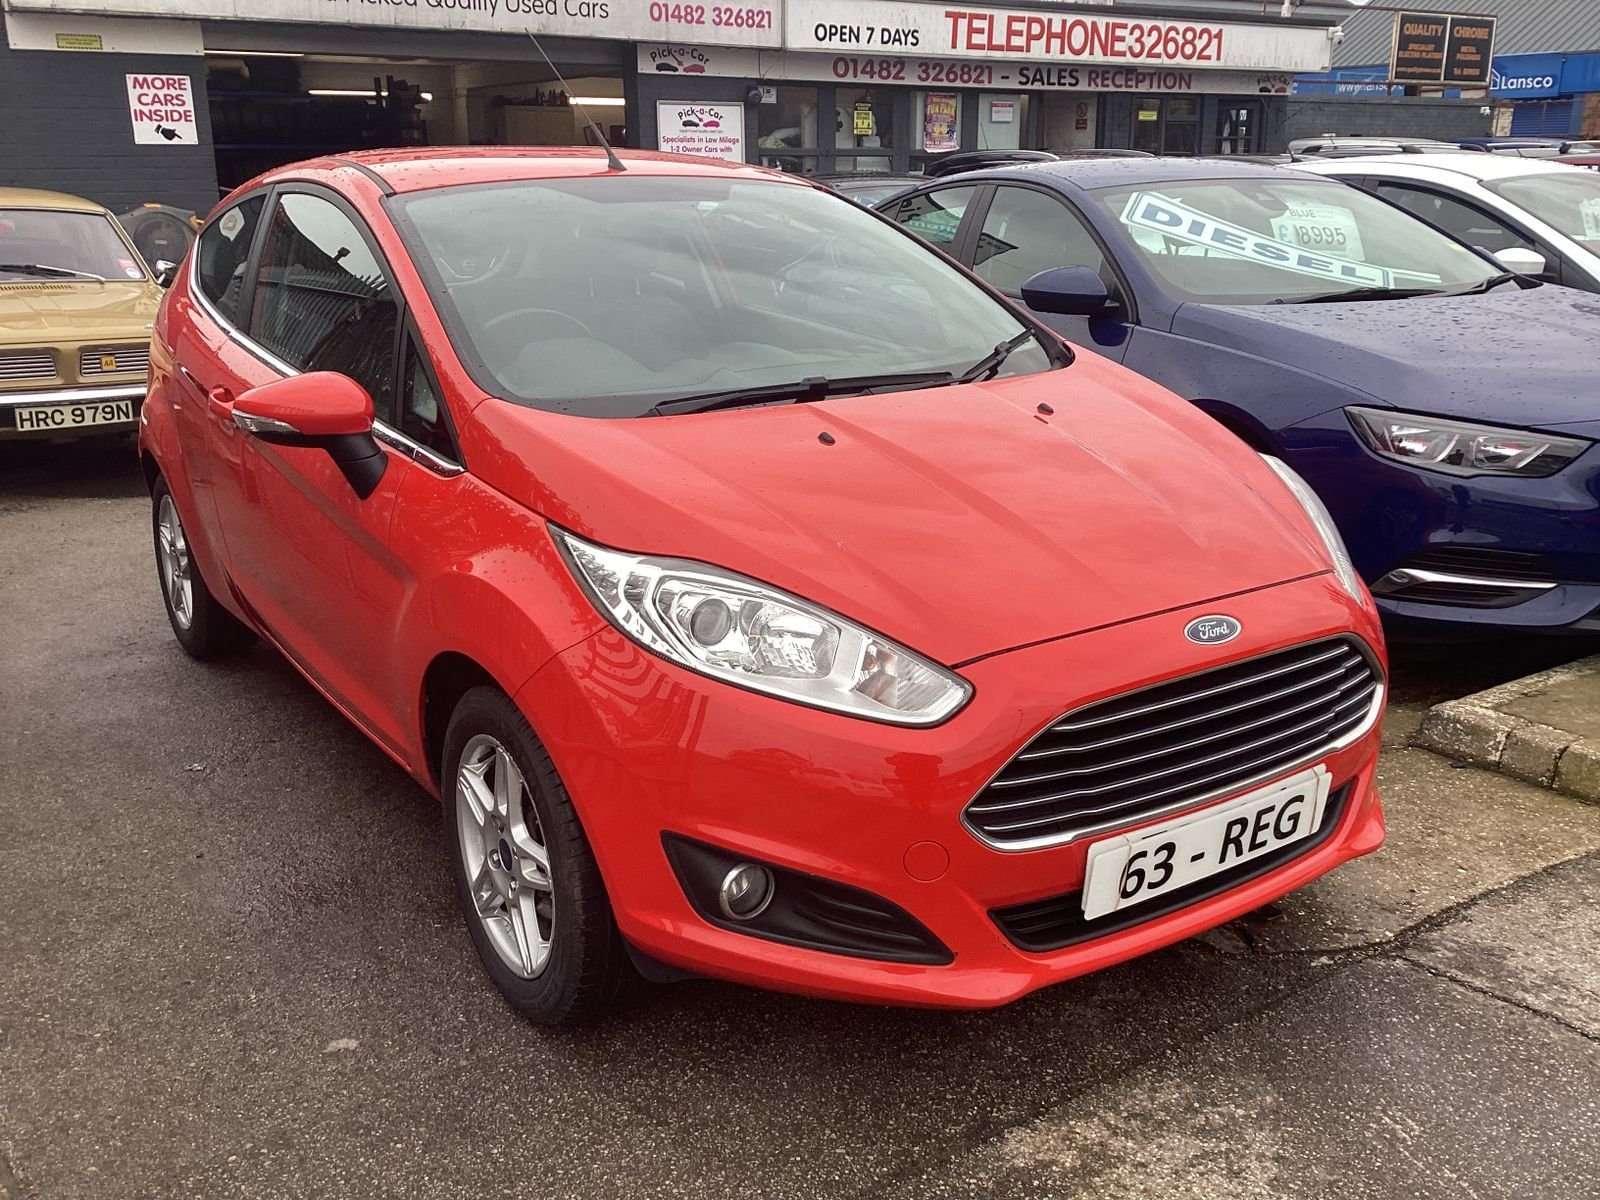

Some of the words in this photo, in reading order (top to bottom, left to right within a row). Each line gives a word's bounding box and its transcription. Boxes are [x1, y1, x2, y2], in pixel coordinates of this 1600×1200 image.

[505, 0, 558, 15] Used
[564, 0, 609, 19] Cars
[650, 2, 705, 26] 01482
[712, 5, 773, 30] 326821
[814, 22, 861, 44] OPEN
[866, 26, 875, 44] 7
[880, 27, 920, 47] DAYS
[1403, 23, 1444, 37] QUALITY
[649, 45, 710, 65] Pick-a-Car
[832, 57, 906, 81] 01482
[917, 61, 993, 85] 326821
[1017, 65, 1080, 88] SALES
[1087, 68, 1192, 91] RECEPTION
[132, 76, 188, 91] MORE
[1501, 75, 1553, 90] Lansco
[137, 93, 186, 107] CARS
[133, 109, 193, 123] INSIDE
[677, 106, 723, 121] Pick-a-Car
[662, 135, 696, 144] Specialists
[681, 145, 703, 153] Owner
[704, 145, 718, 153] Cars
[719, 145, 733, 153] with
[1289, 208, 1317, 218] BLUE
[1141, 203, 1376, 282] DIESEL
[103, 359, 114, 368] AA
[19, 409, 65, 430] HRC
[71, 402, 131, 424] 979N
[1197, 621, 1230, 640] Ford
[1118, 840, 1177, 900] 63
[1218, 793, 1305, 865] REG
